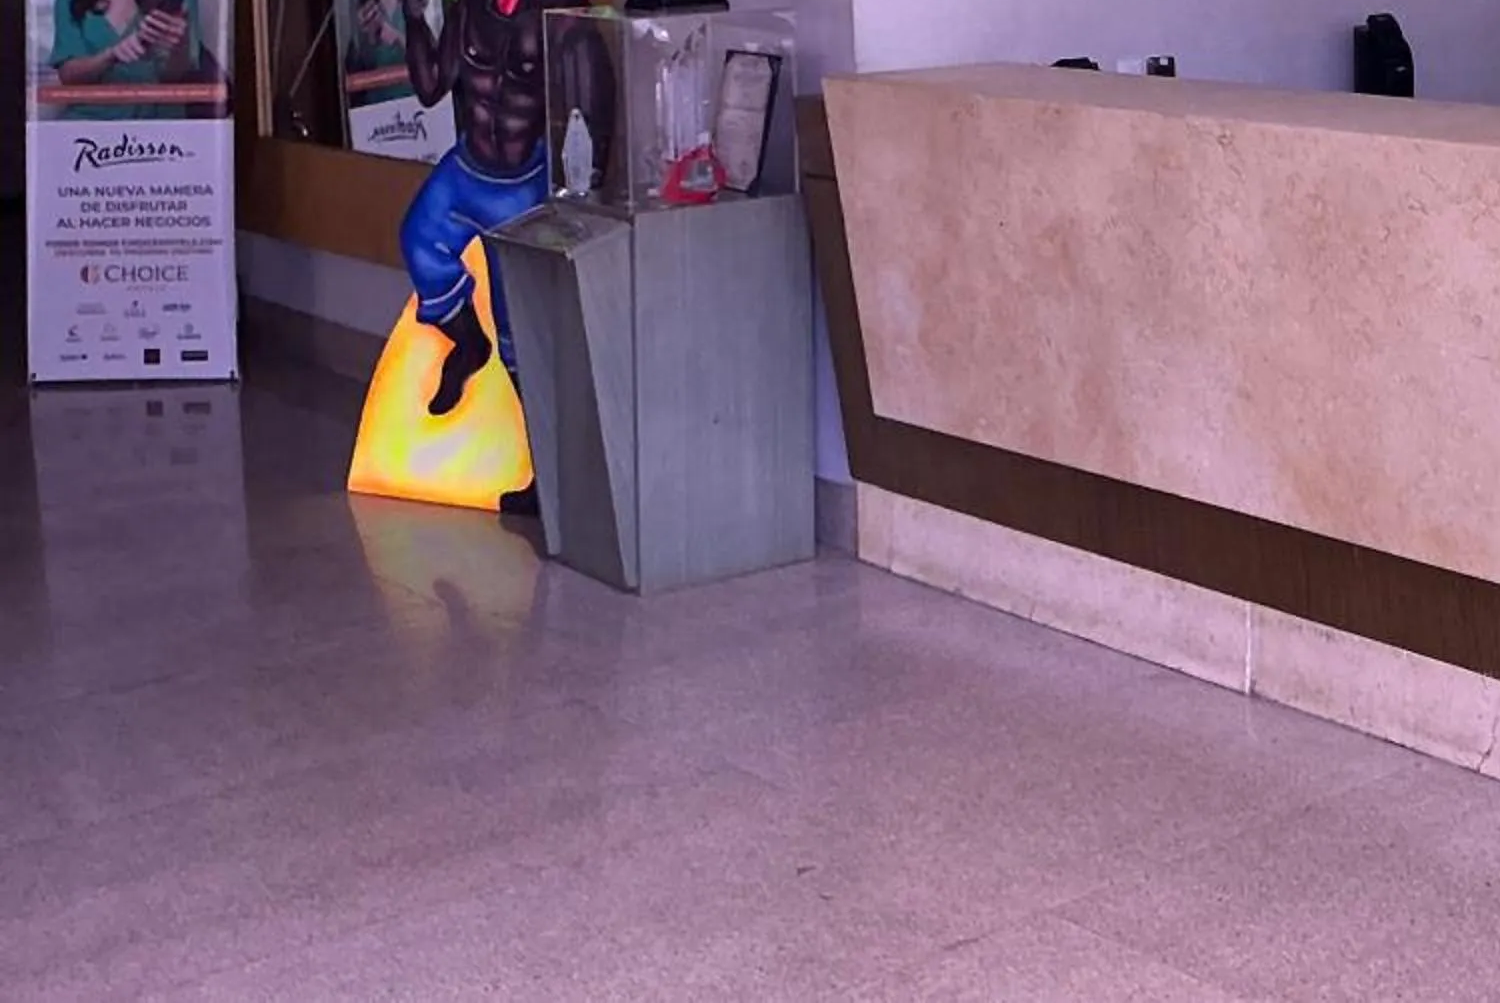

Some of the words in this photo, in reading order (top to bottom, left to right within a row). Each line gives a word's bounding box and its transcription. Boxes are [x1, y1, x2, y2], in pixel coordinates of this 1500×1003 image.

[73, 133, 185, 173] Radisson
[57, 186, 91, 198] UNA
[94, 185, 146, 198] NUEVA
[149, 184, 214, 197] MANERA
[80, 201, 102, 213] DE
[105, 200, 188, 213] DISFRUTAR
[56, 217, 76, 229] AL
[79, 216, 132, 229] HACER
[134, 215, 212, 228] NEGOCIOS
[104, 264, 189, 283] CHOICE
